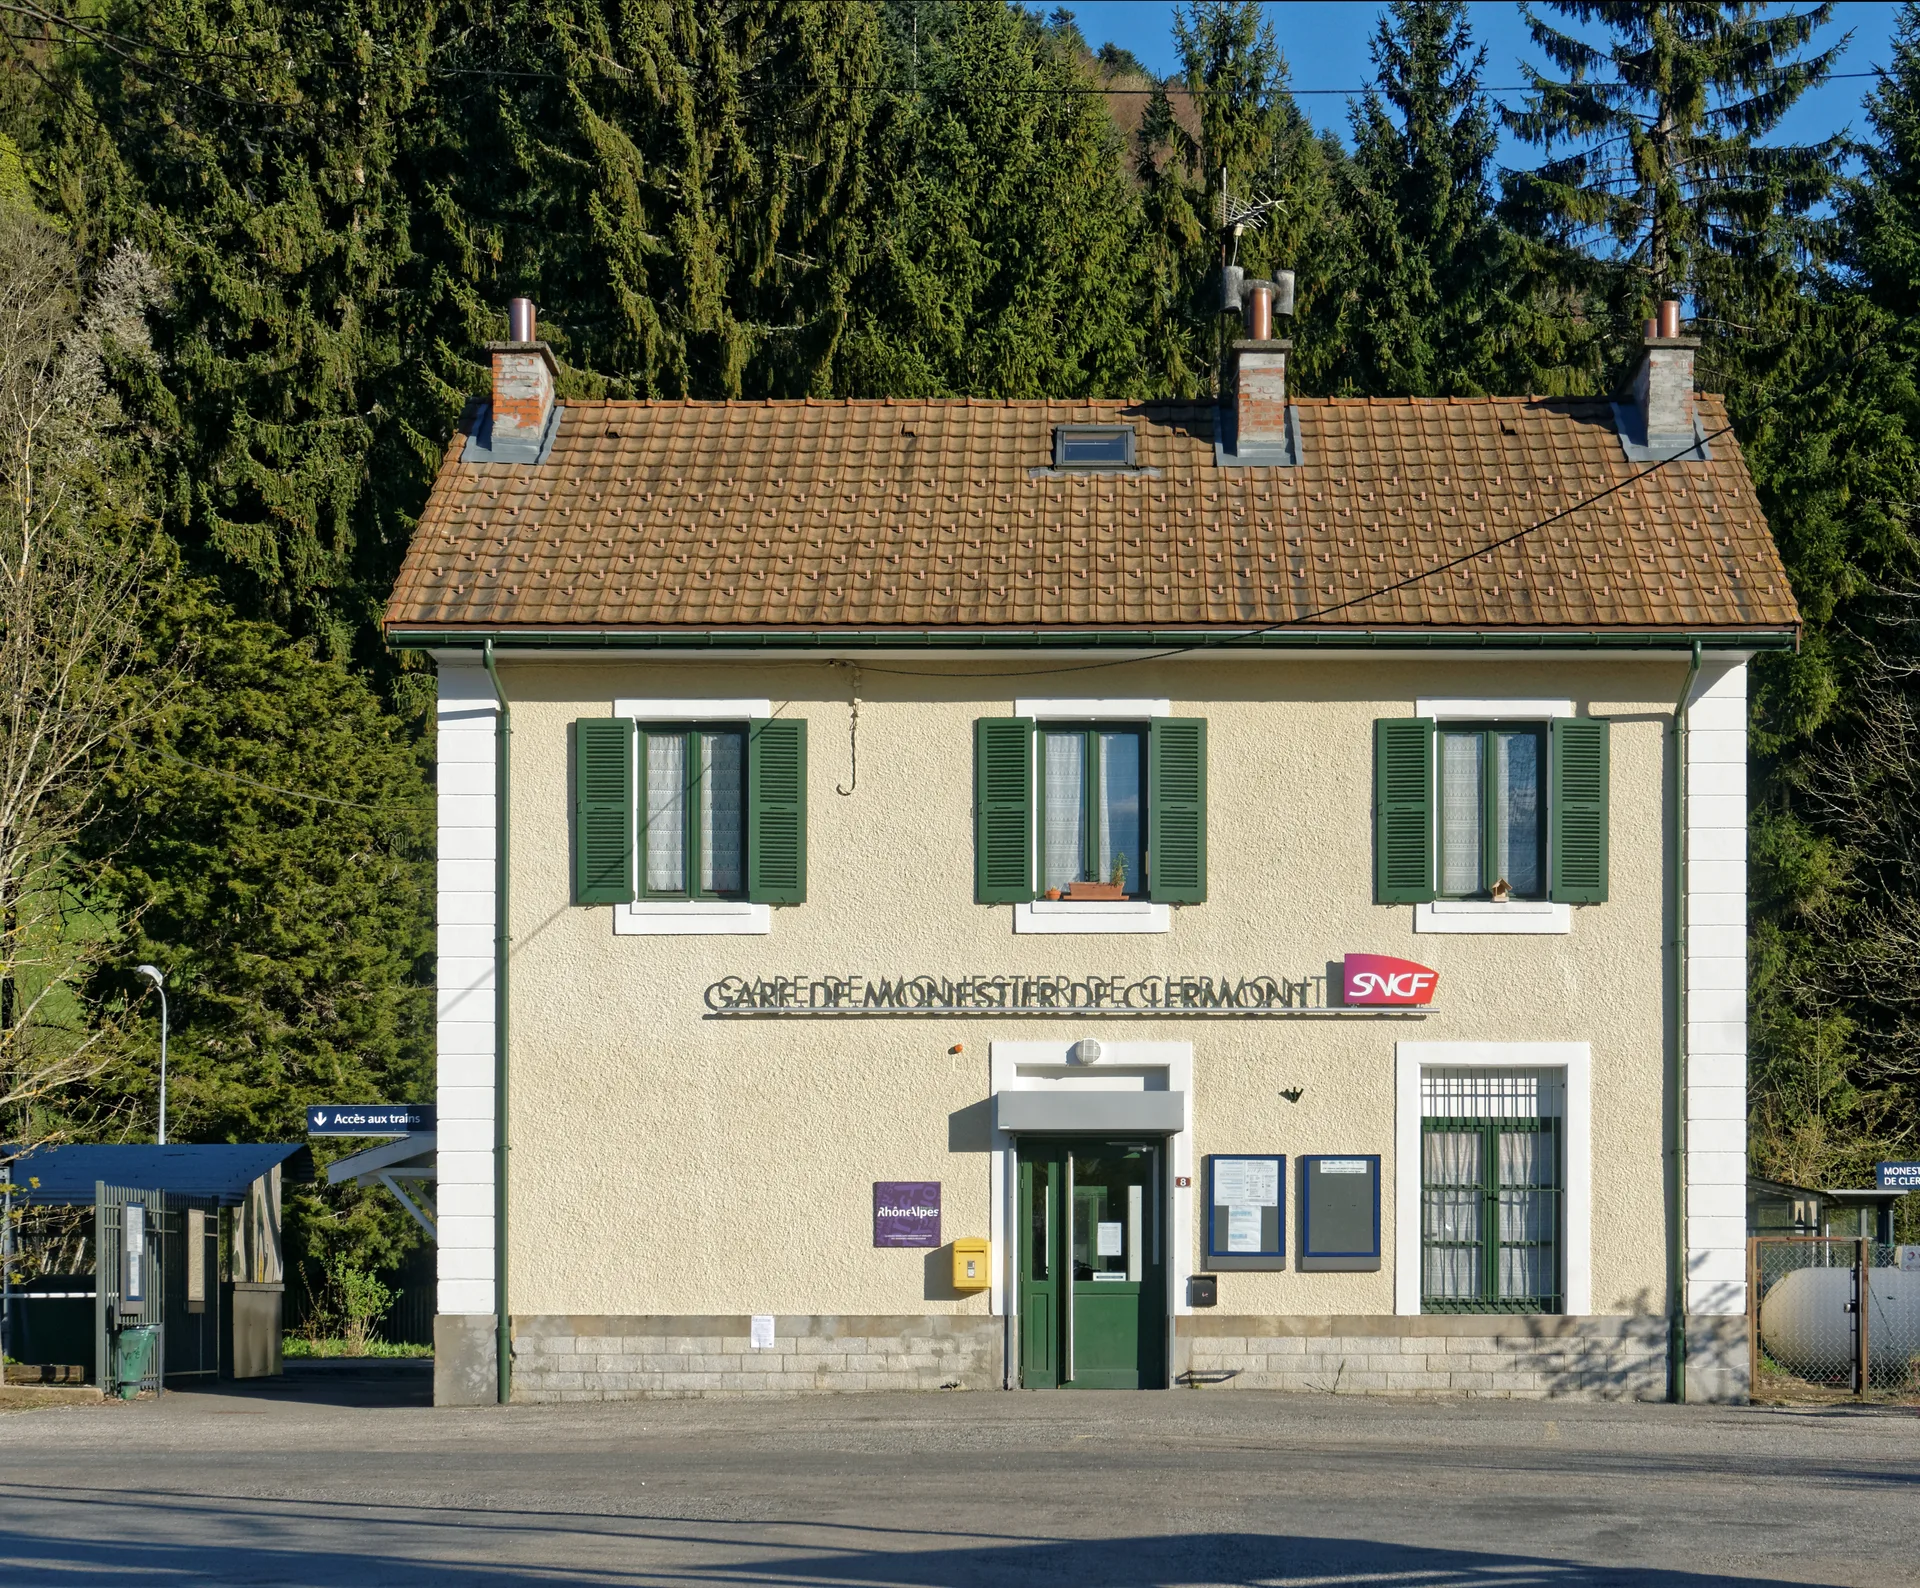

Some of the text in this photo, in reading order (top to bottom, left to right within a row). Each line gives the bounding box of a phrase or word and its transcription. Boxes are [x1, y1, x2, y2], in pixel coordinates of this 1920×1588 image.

[718, 975, 1326, 1004] GARE DE MONESTIER DE CLERMONT
[1348, 972, 1435, 997] SNCF
[334, 1113, 420, 1124] Accès aux trains
[1180, 1178, 1187, 1187] 8
[1884, 1177, 1897, 1186] DE
